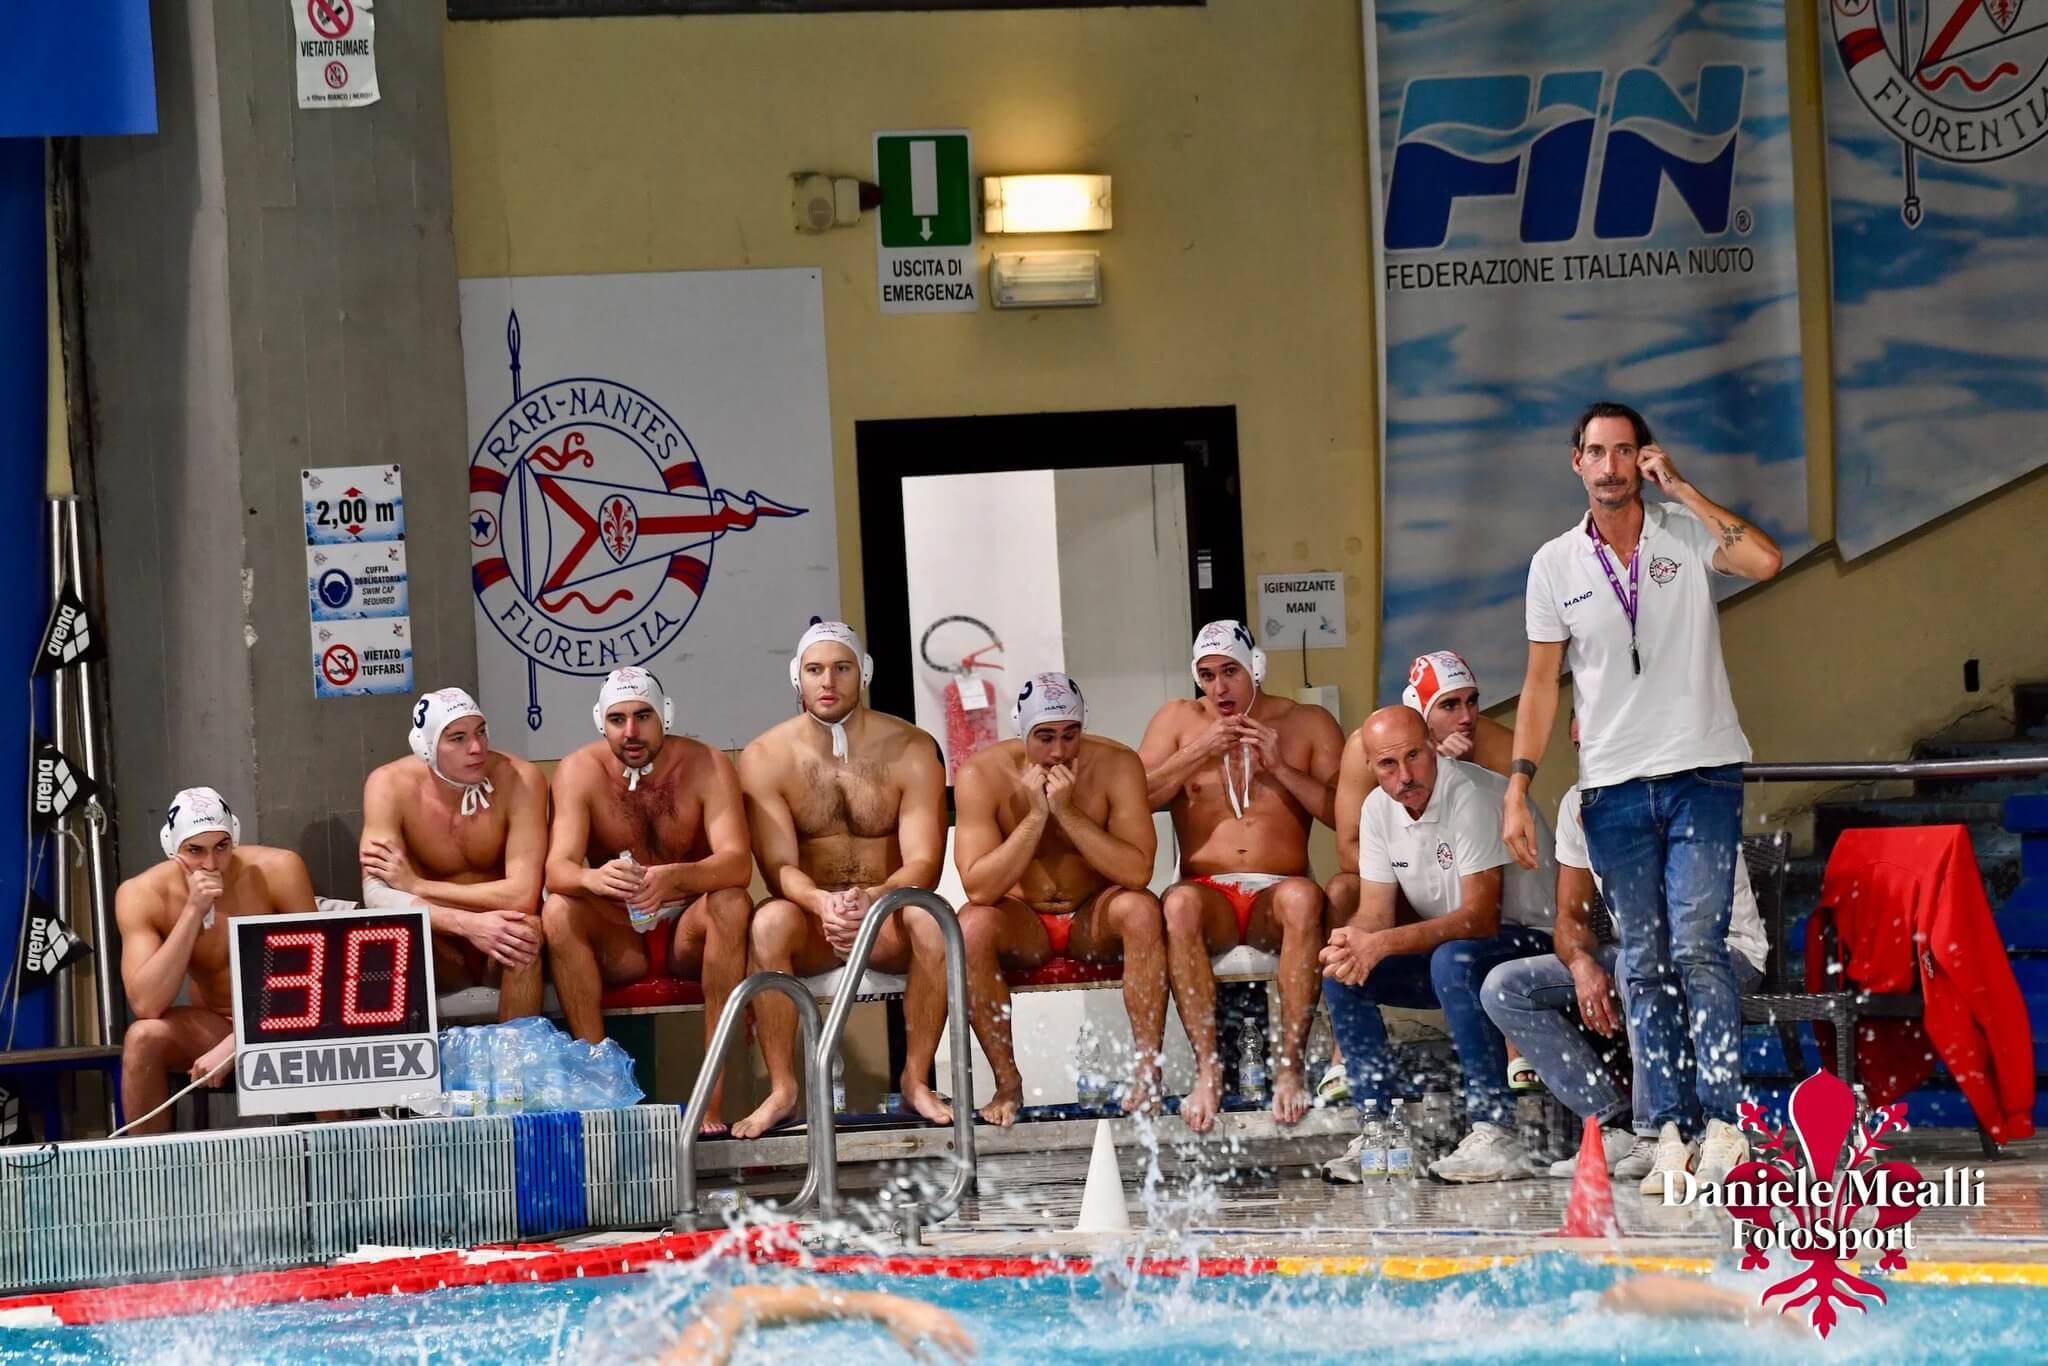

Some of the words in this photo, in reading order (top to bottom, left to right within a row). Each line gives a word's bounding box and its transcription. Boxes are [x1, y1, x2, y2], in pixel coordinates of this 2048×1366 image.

[300, 40, 334, 57] VIETATO
[335, 39, 369, 56] FUMARE
[1384, 65, 1745, 250] FIN
[893, 260, 944, 278] USCITA
[949, 259, 962, 276] DI
[1385, 257, 1554, 290] FEDERAZIONE
[1563, 251, 1681, 281] ITALIANA
[1688, 247, 1754, 274] NUOTO
[883, 283, 975, 302] EMERGENZA
[487, 387, 678, 467] RARI-NANTES
[316, 498, 367, 529] 2,00
[375, 502, 395, 522] m
[365, 565, 390, 574] CUFFIA
[354, 575, 401, 585] OBBLIGATORIA
[1264, 580, 1336, 594] IGIENIZZANTE
[362, 587, 380, 595] SWIM
[382, 585, 395, 594] CAP
[1563, 591, 1593, 608] HAND
[363, 597, 396, 606] REQUIRED
[1286, 602, 1316, 614] MANI
[47, 604, 77, 657] arena
[501, 600, 680, 667] FLORENTIA
[364, 649, 401, 661] VIETATO
[361, 663, 405, 676] TUFFARSI
[414, 699, 430, 729] 3
[36, 759, 54, 813] arena
[26, 917, 47, 972] arena
[260, 927, 411, 1031] 30
[251, 1042, 427, 1087] AEMMEX
